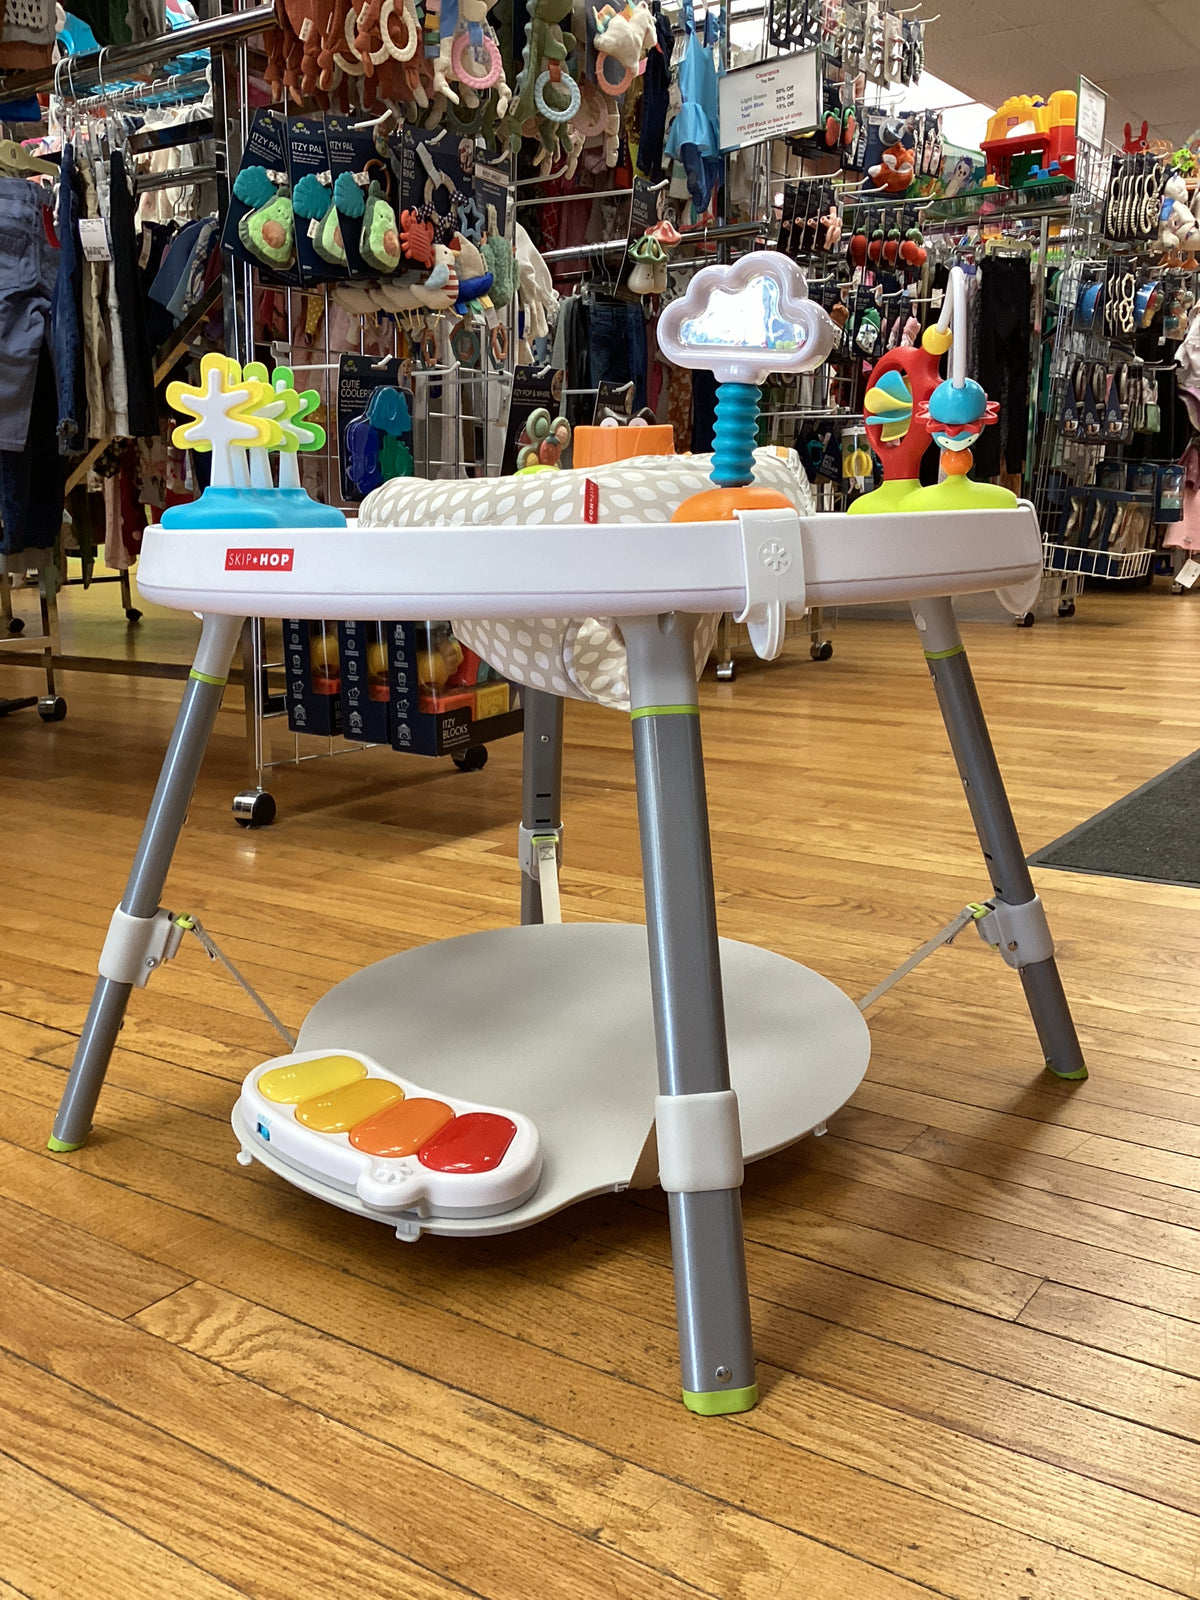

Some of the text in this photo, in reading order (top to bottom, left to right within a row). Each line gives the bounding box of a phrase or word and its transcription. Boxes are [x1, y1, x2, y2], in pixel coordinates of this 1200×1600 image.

[755, 69, 780, 79] Clearance
[740, 96, 752, 104] Light
[753, 93, 767, 101] Green
[740, 104, 752, 112] Light
[252, 131, 269, 146] ITZY
[268, 142, 282, 155] PAL
[291, 141, 308, 151] ITZY
[308, 143, 324, 154] PAL
[329, 140, 354, 151] ITZY PAL
[341, 379, 360, 389] CUTIE
[340, 388, 372, 398] COOLERS
[522, 389, 532, 397] POP
[228, 553, 290, 566] SKIP HOP
[442, 717, 456, 729] ITZY
[442, 723, 468, 740] BLOCKS
